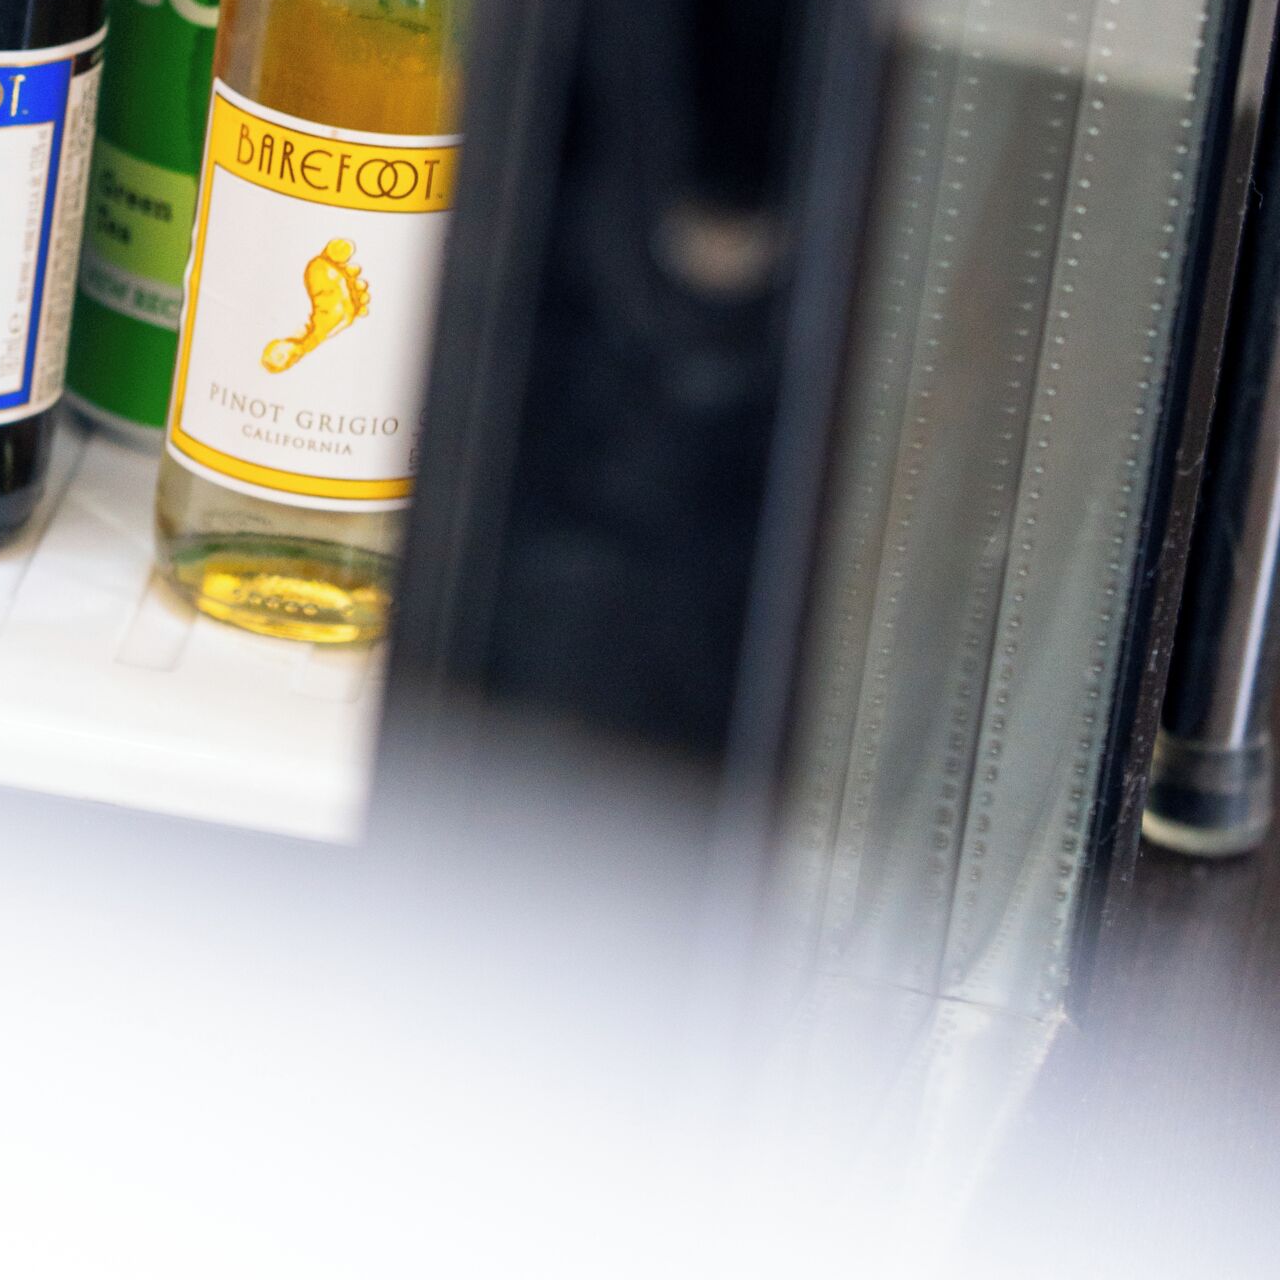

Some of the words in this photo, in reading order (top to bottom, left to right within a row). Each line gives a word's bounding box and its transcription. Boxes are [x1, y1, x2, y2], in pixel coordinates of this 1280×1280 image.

[236, 123, 440, 202] BAREFOOT
[209, 382, 285, 424] PINOT
[295, 410, 401, 436] GRIGIO
[241, 424, 353, 455] CALIFORNIA
